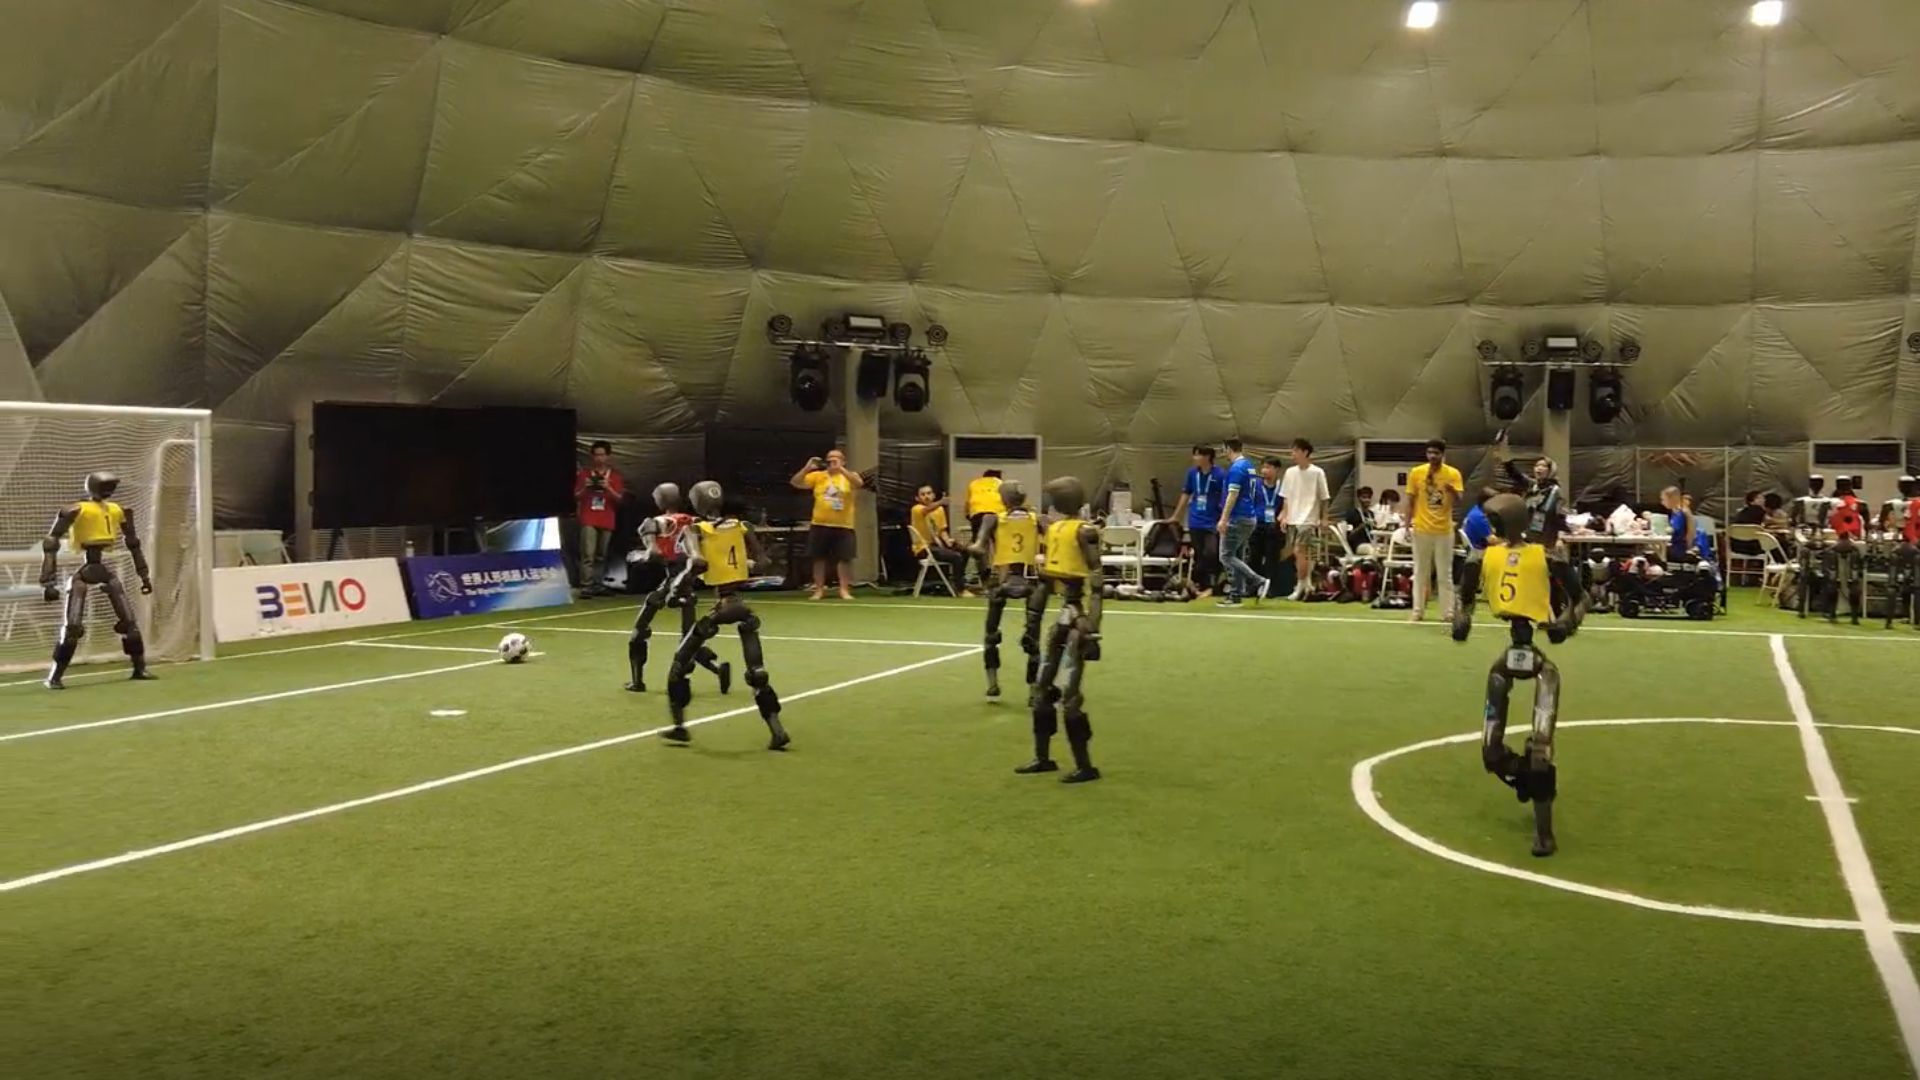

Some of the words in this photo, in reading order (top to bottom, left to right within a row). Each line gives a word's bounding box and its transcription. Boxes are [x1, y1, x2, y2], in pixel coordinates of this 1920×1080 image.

[104, 515, 111, 535] 1
[1012, 532, 1024, 553] 3
[727, 545, 738, 569] 4
[1500, 571, 1518, 602] 5
